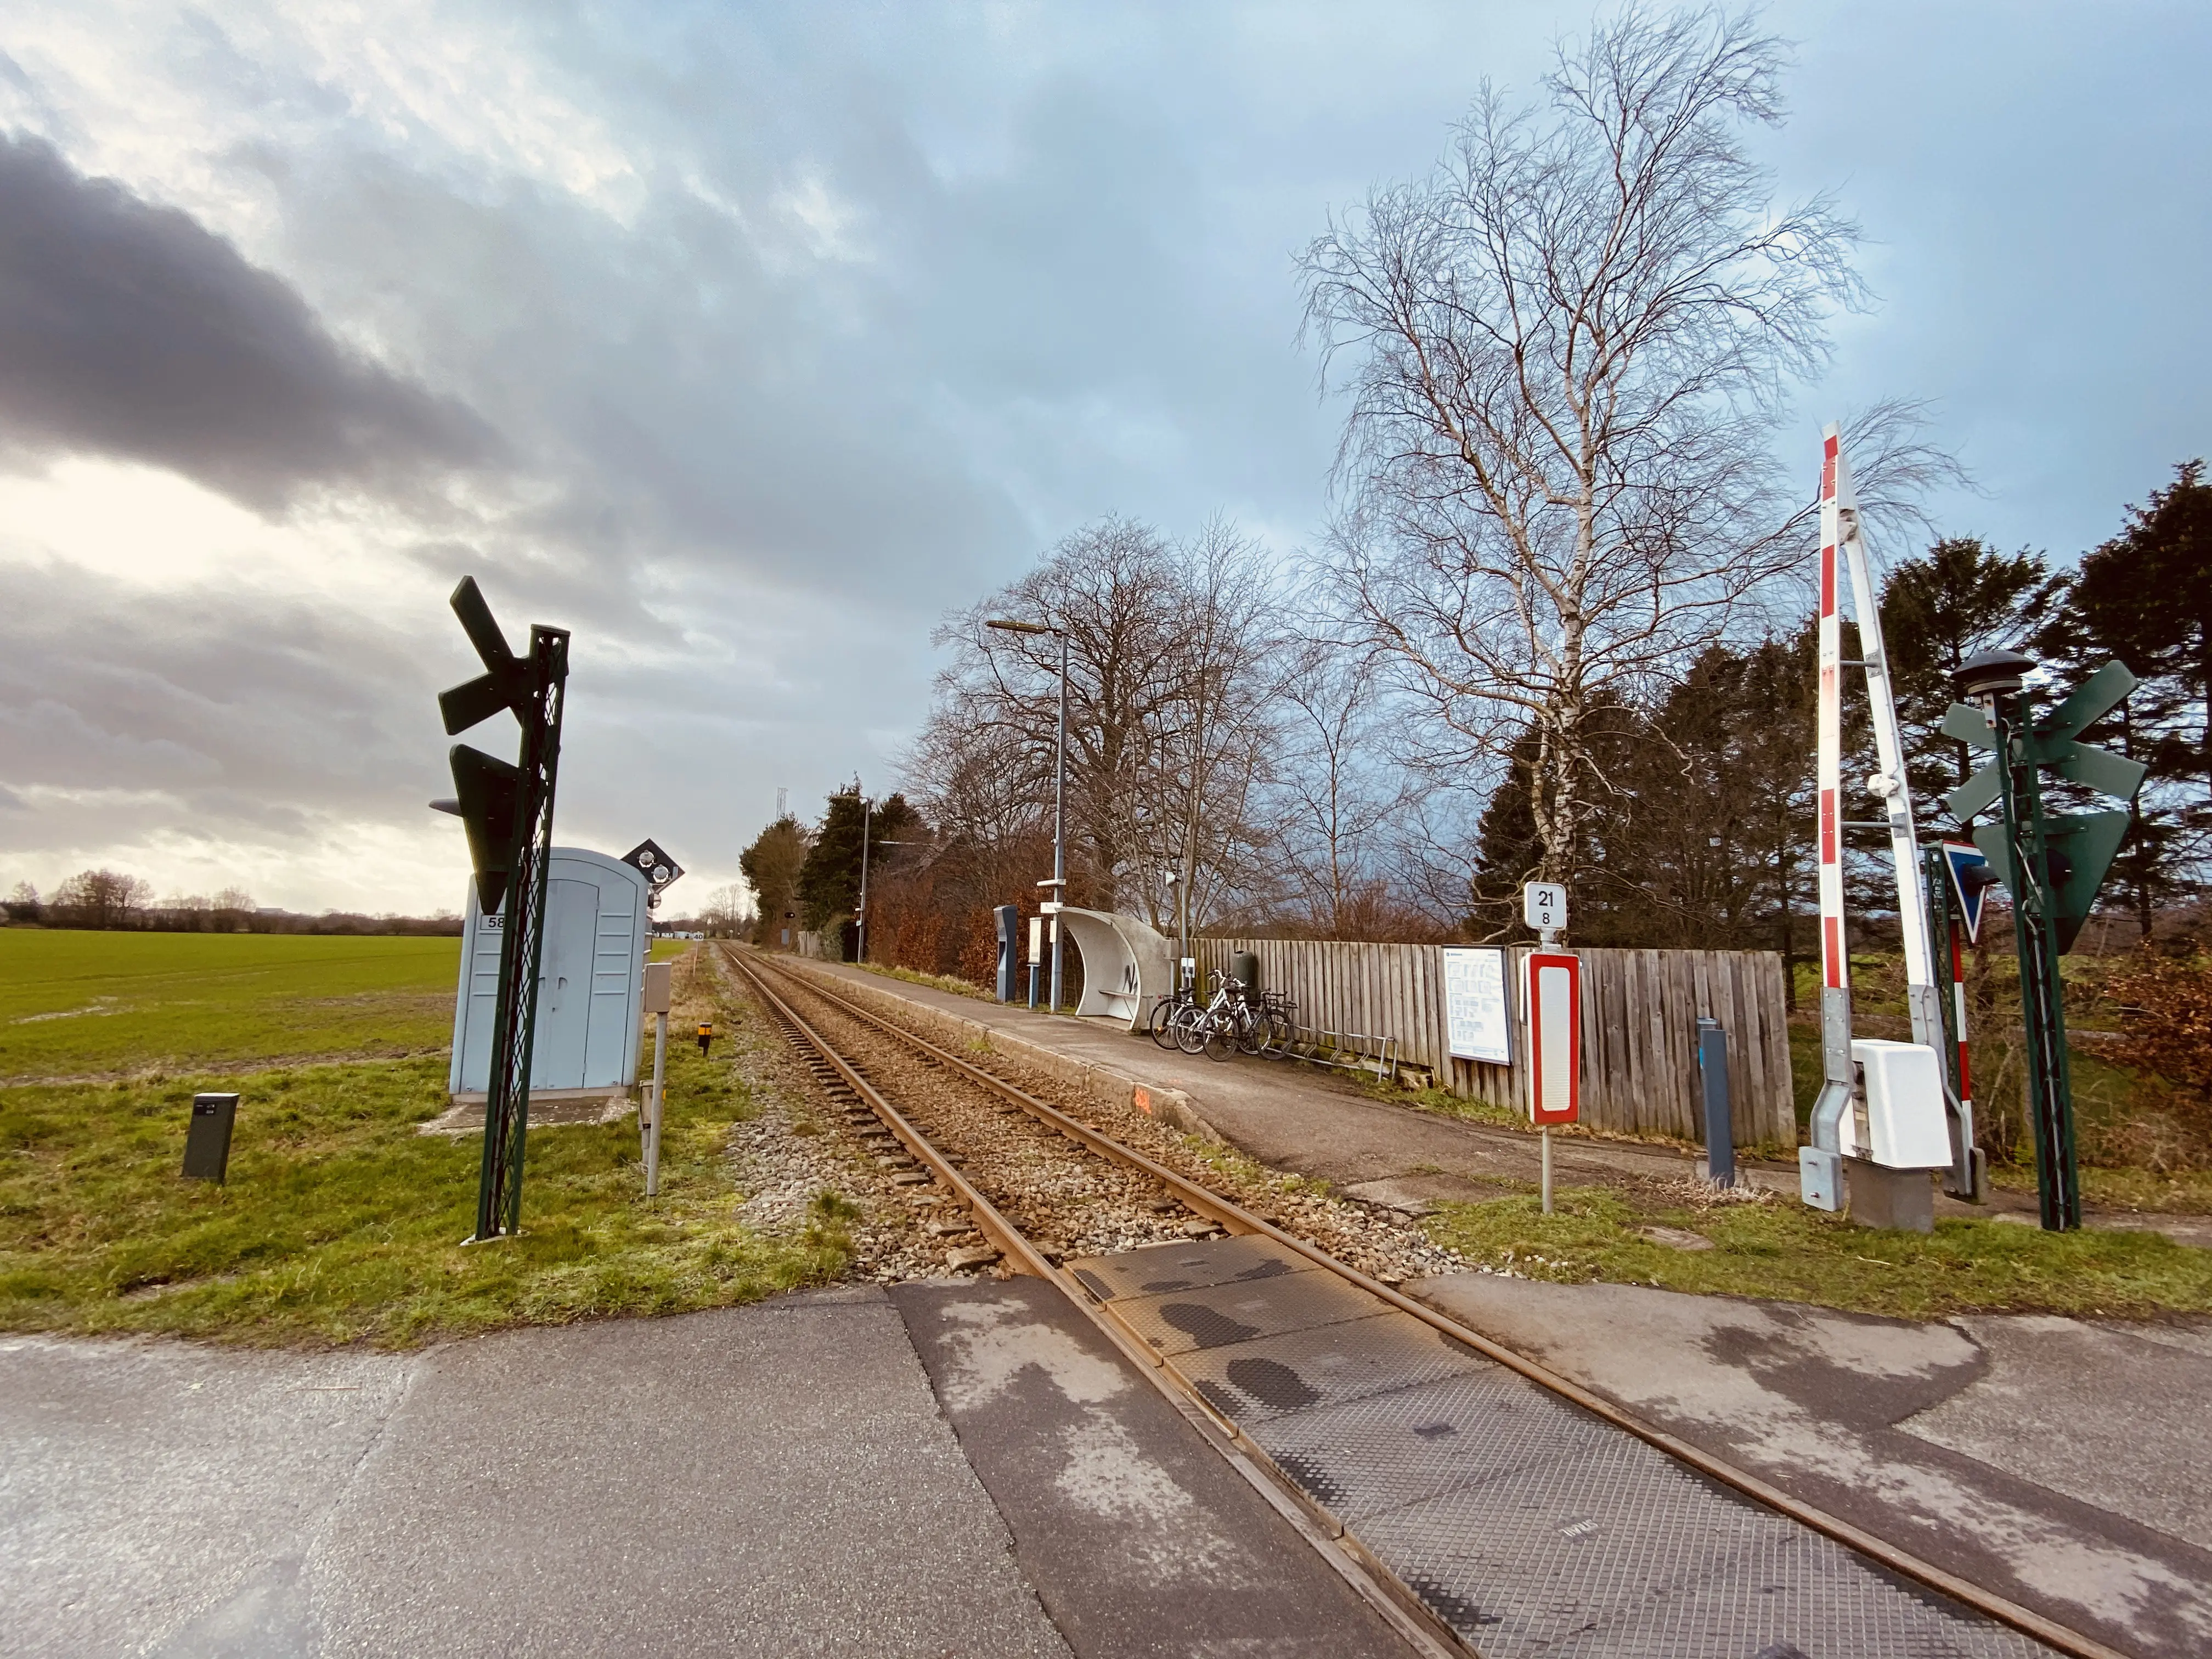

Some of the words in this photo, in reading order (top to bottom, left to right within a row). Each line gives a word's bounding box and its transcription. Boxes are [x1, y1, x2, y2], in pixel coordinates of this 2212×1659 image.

[1538, 890, 1553, 907] 21
[488, 917, 505, 927] 58
[1543, 912, 1550, 924] 8
[1558, 1519, 1598, 1537] STRAIL
